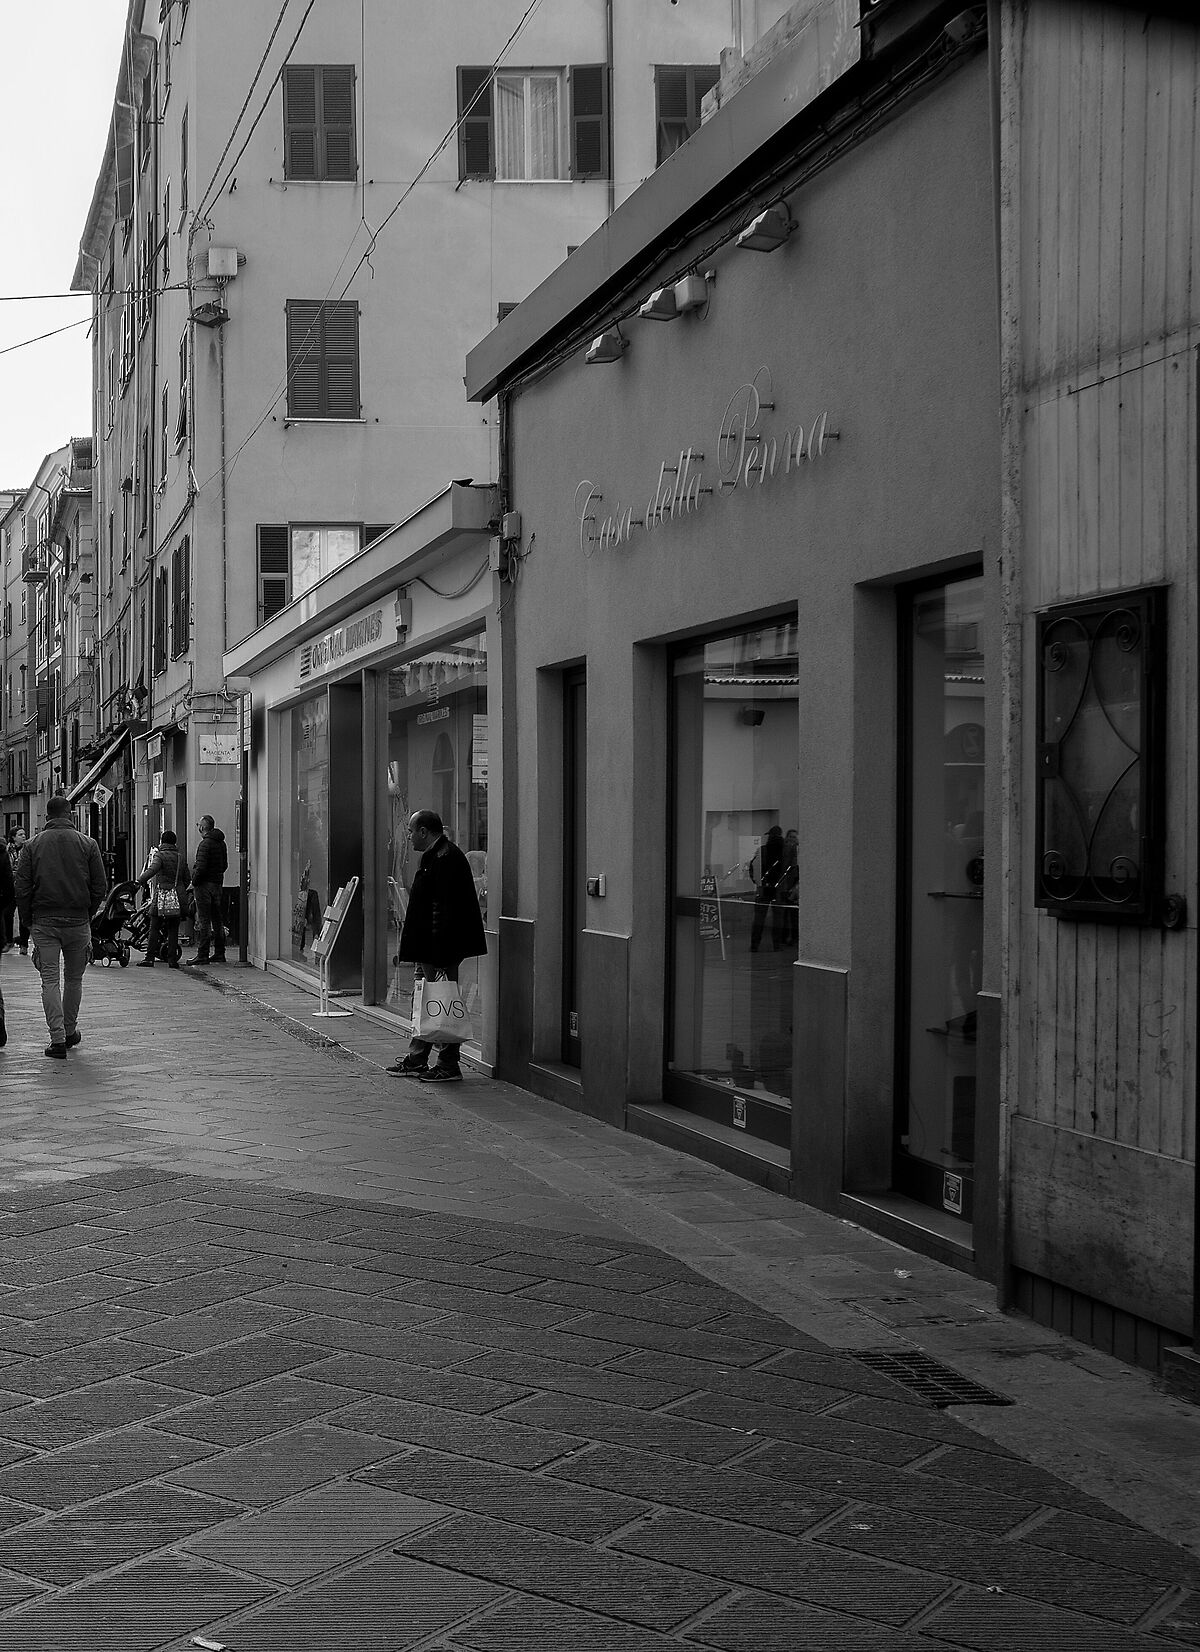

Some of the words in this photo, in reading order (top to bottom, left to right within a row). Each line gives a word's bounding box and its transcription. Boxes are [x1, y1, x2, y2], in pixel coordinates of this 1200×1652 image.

[646, 447, 703, 531] della
[717, 366, 829, 497] Penna
[426, 1000, 465, 1019] OVS
